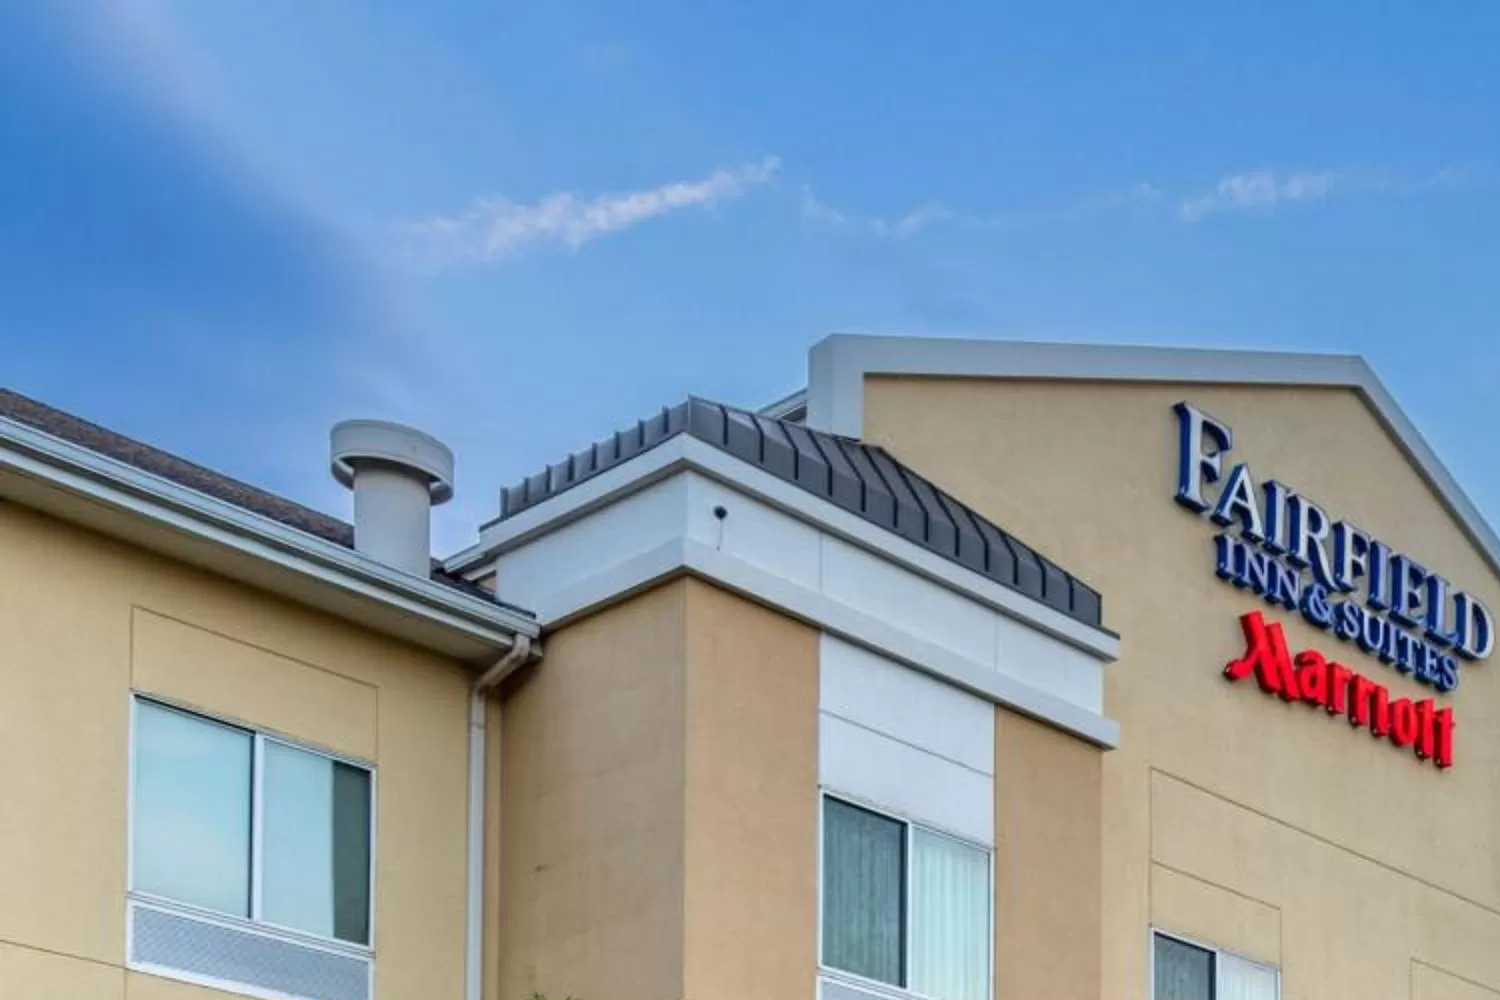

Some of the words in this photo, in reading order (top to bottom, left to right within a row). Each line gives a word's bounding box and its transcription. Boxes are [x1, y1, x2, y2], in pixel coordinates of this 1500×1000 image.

[1173, 401, 1496, 661] FAIRFIELD
[1213, 533, 1301, 611] INN
[1301, 583, 1335, 629] &
[1335, 601, 1460, 693] SUITES
[1223, 609, 1454, 769] Marriott
